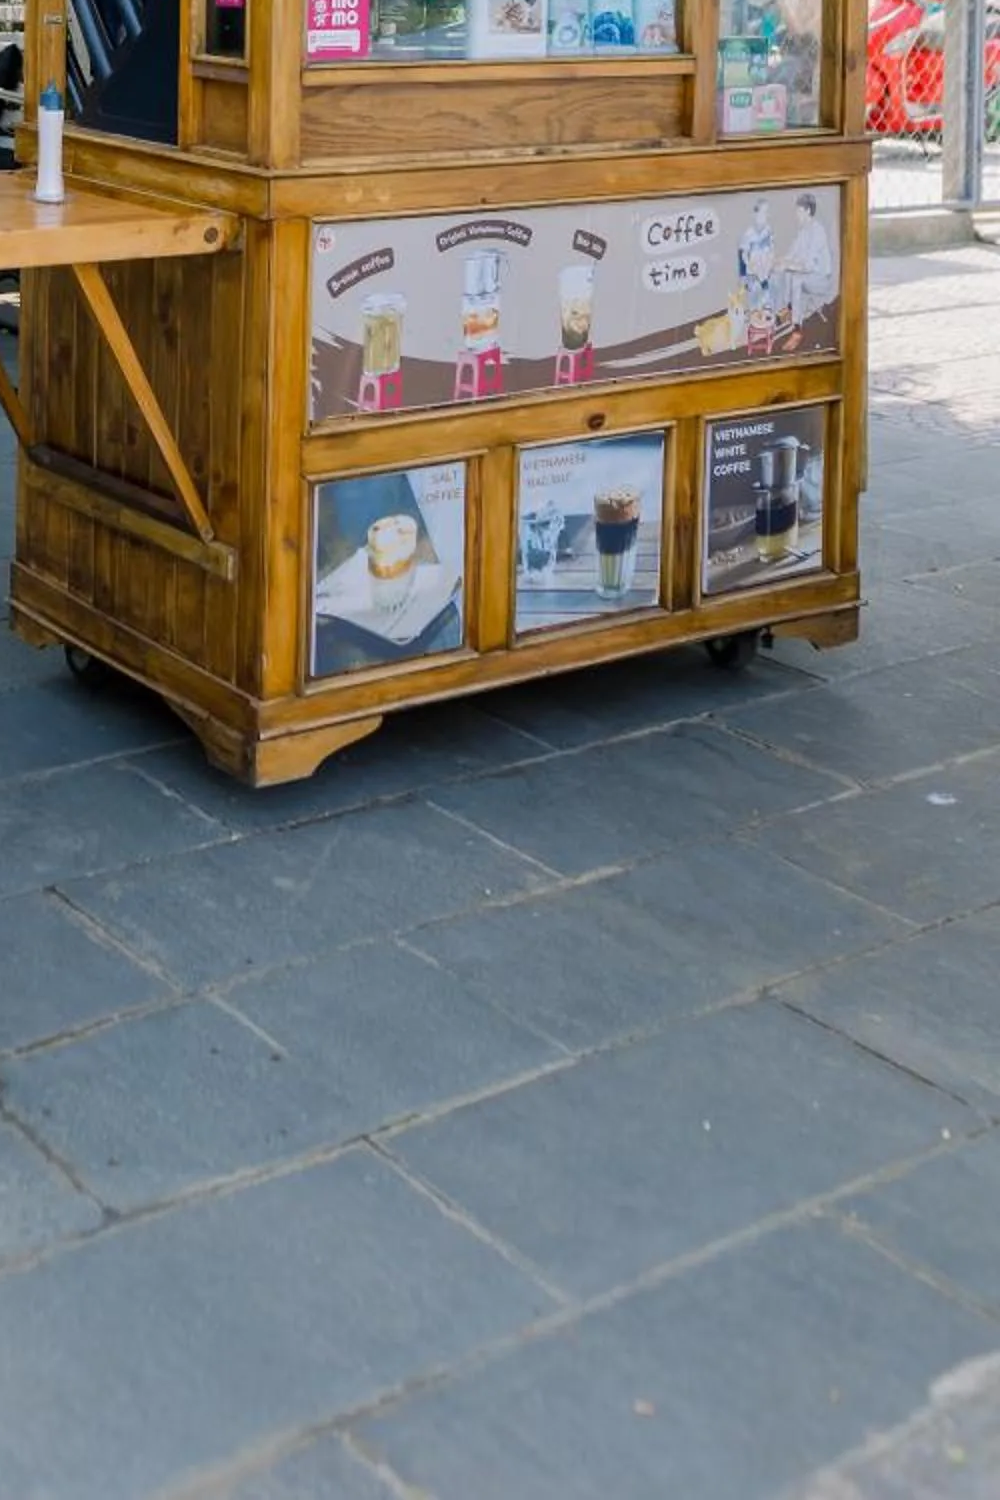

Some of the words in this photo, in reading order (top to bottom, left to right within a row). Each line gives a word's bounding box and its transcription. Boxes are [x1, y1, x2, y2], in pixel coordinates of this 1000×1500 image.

[647, 214, 715, 246] Coffee
[648, 261, 700, 286] time
[715, 422, 775, 442] VIETNAMESE
[714, 443, 747, 459] WHITE
[713, 460, 752, 477] COFFEE
